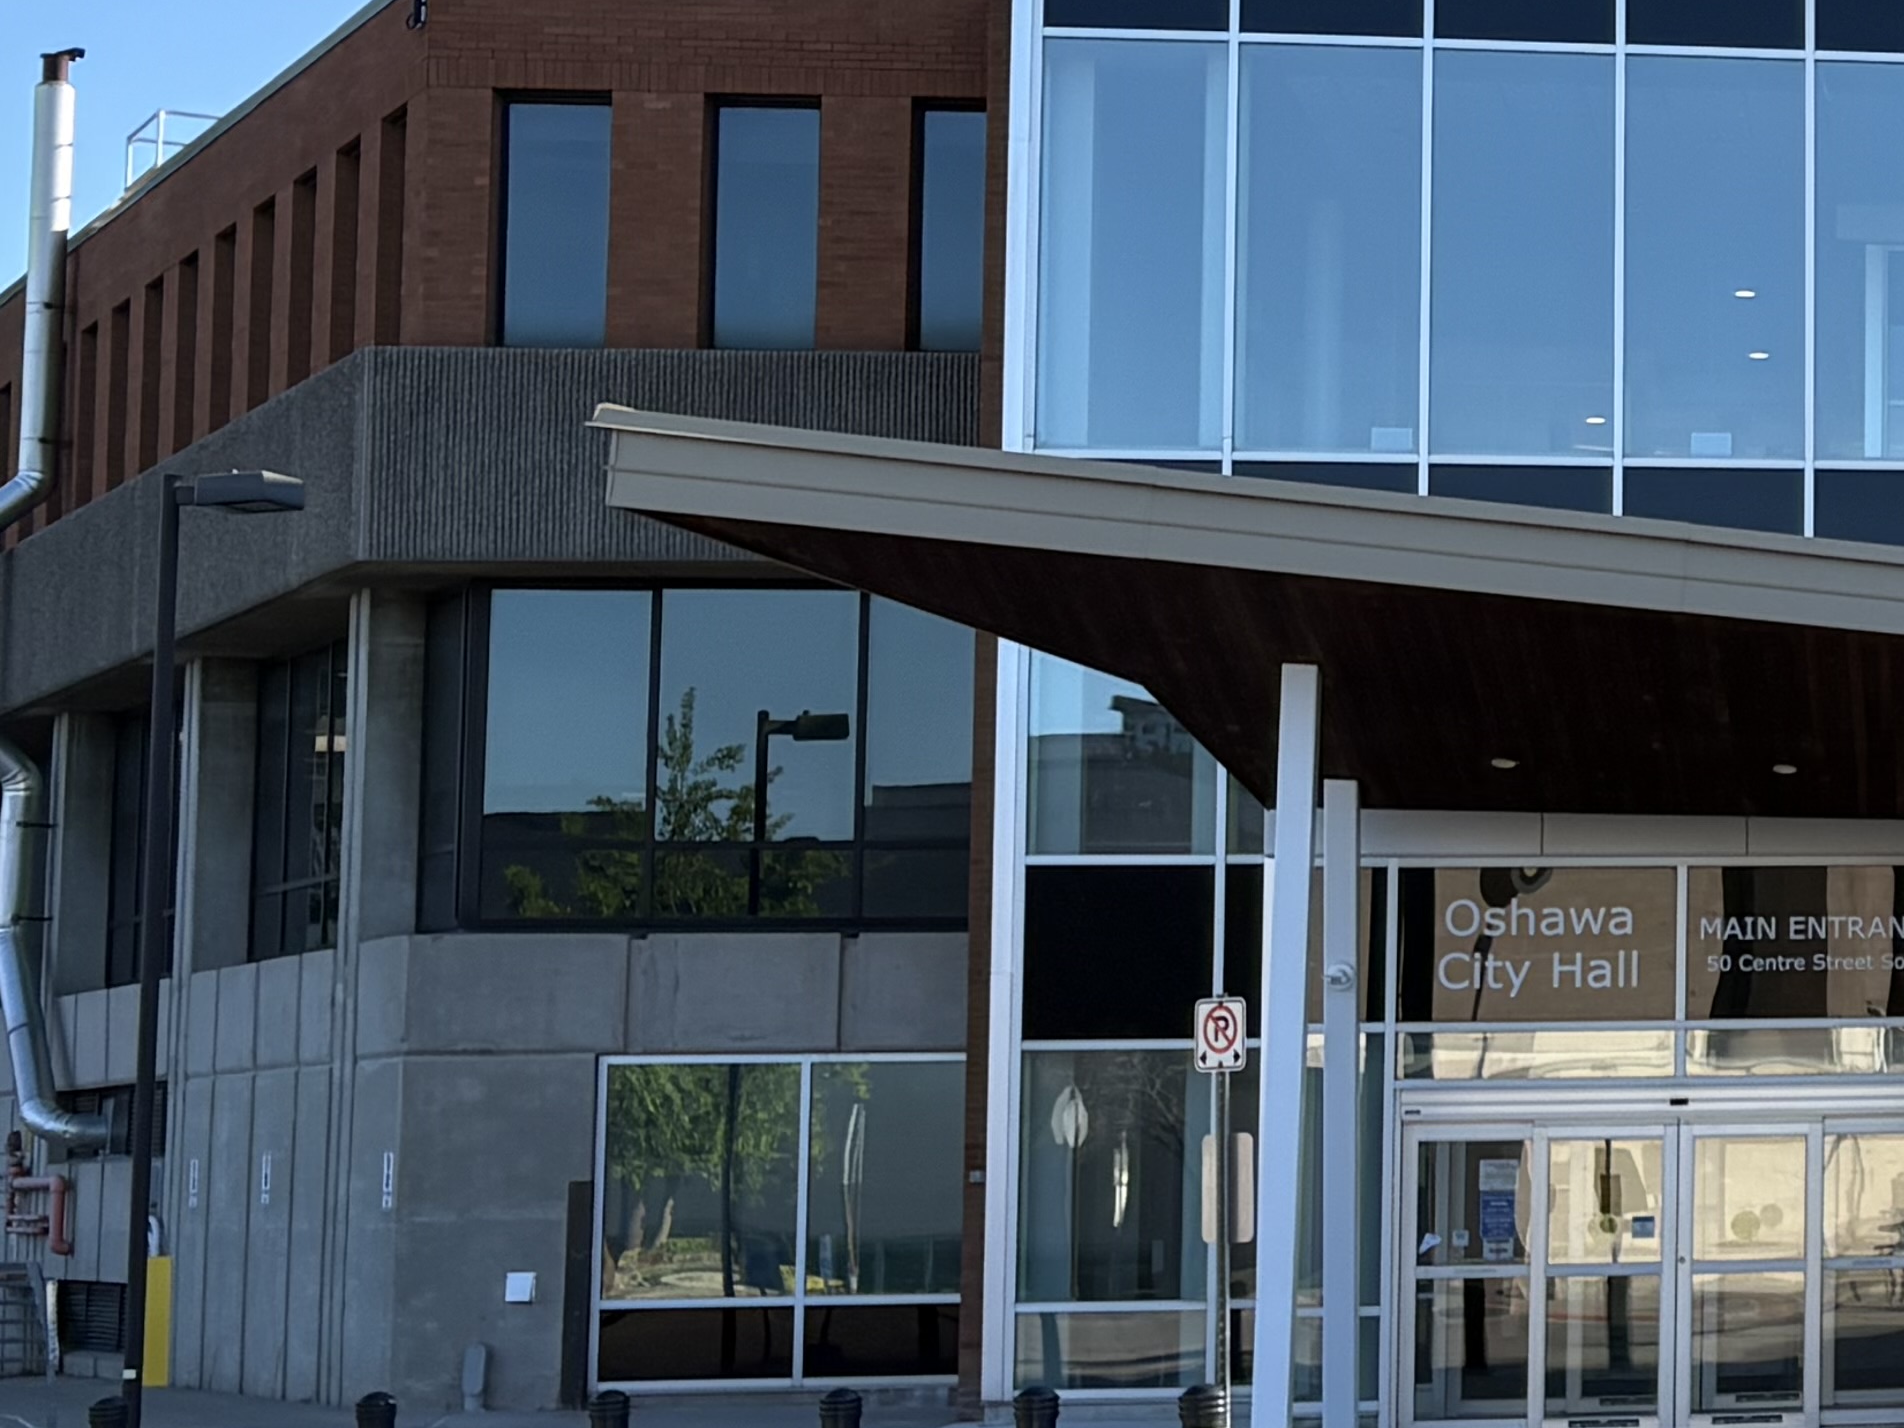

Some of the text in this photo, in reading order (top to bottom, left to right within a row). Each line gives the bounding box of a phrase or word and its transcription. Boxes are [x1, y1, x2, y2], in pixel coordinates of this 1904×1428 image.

[1444, 897, 1634, 937] Oshawa
[1699, 916, 1777, 941] MAIN
[1437, 949, 1640, 998] City Hall
[1706, 954, 1732, 972] 50
[1738, 954, 1806, 972] Centre
[1812, 954, 1873, 972] Street
